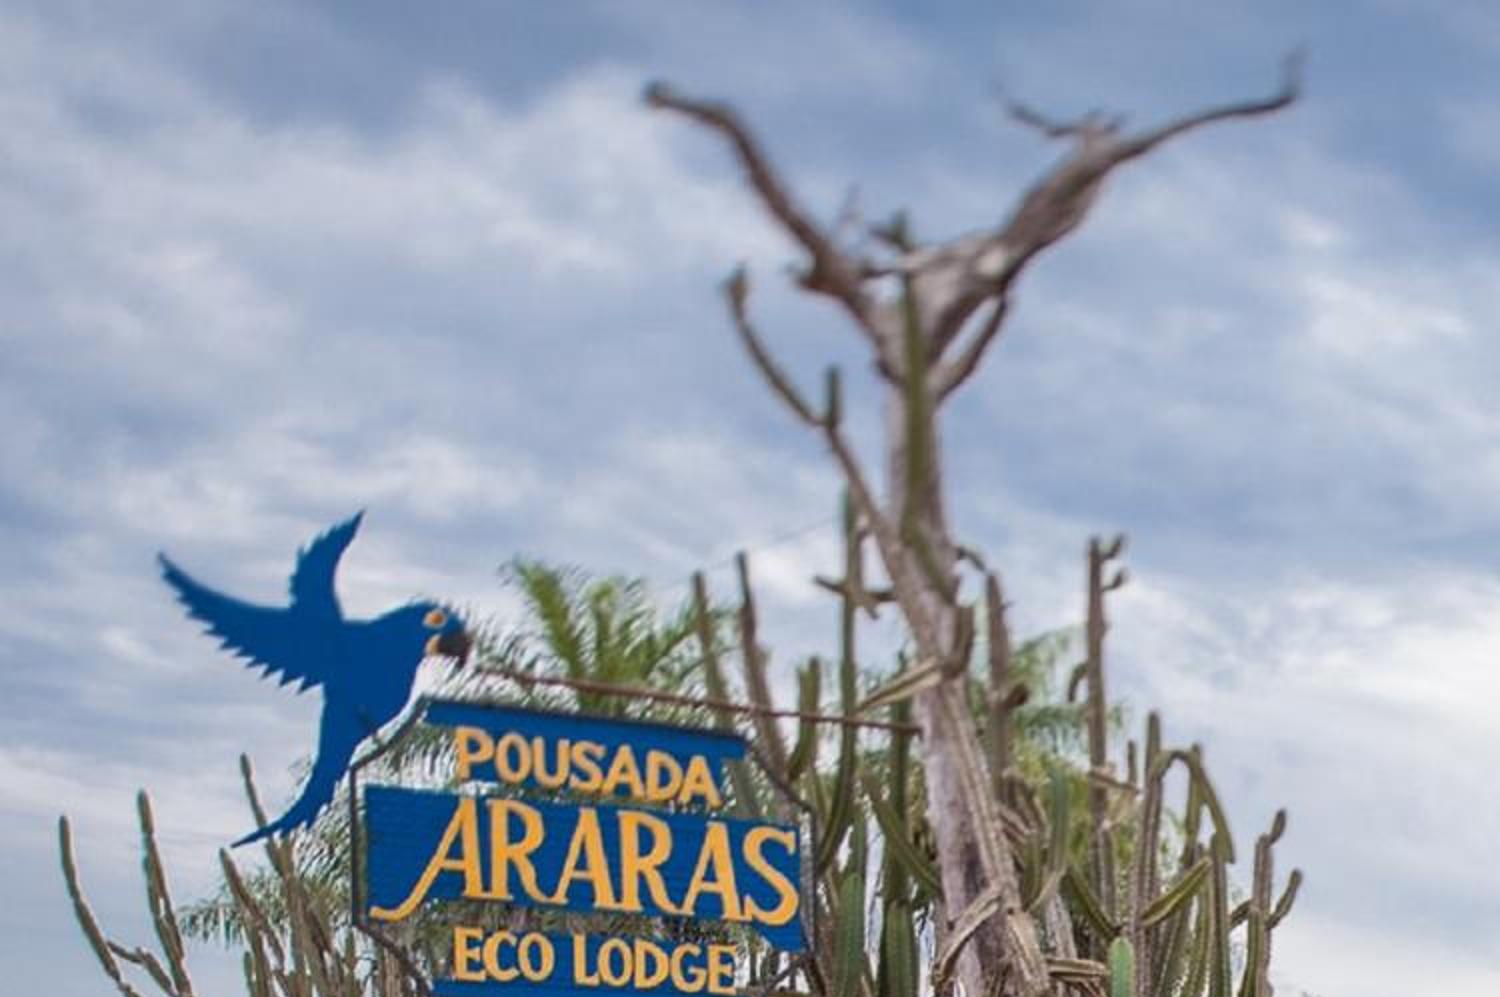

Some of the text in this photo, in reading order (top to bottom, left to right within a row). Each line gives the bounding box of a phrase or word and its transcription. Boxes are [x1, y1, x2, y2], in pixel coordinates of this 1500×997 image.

[455, 726, 722, 808] POUSADA
[369, 797, 800, 927] ARARAS
[453, 926, 738, 995] ECO LODGE
